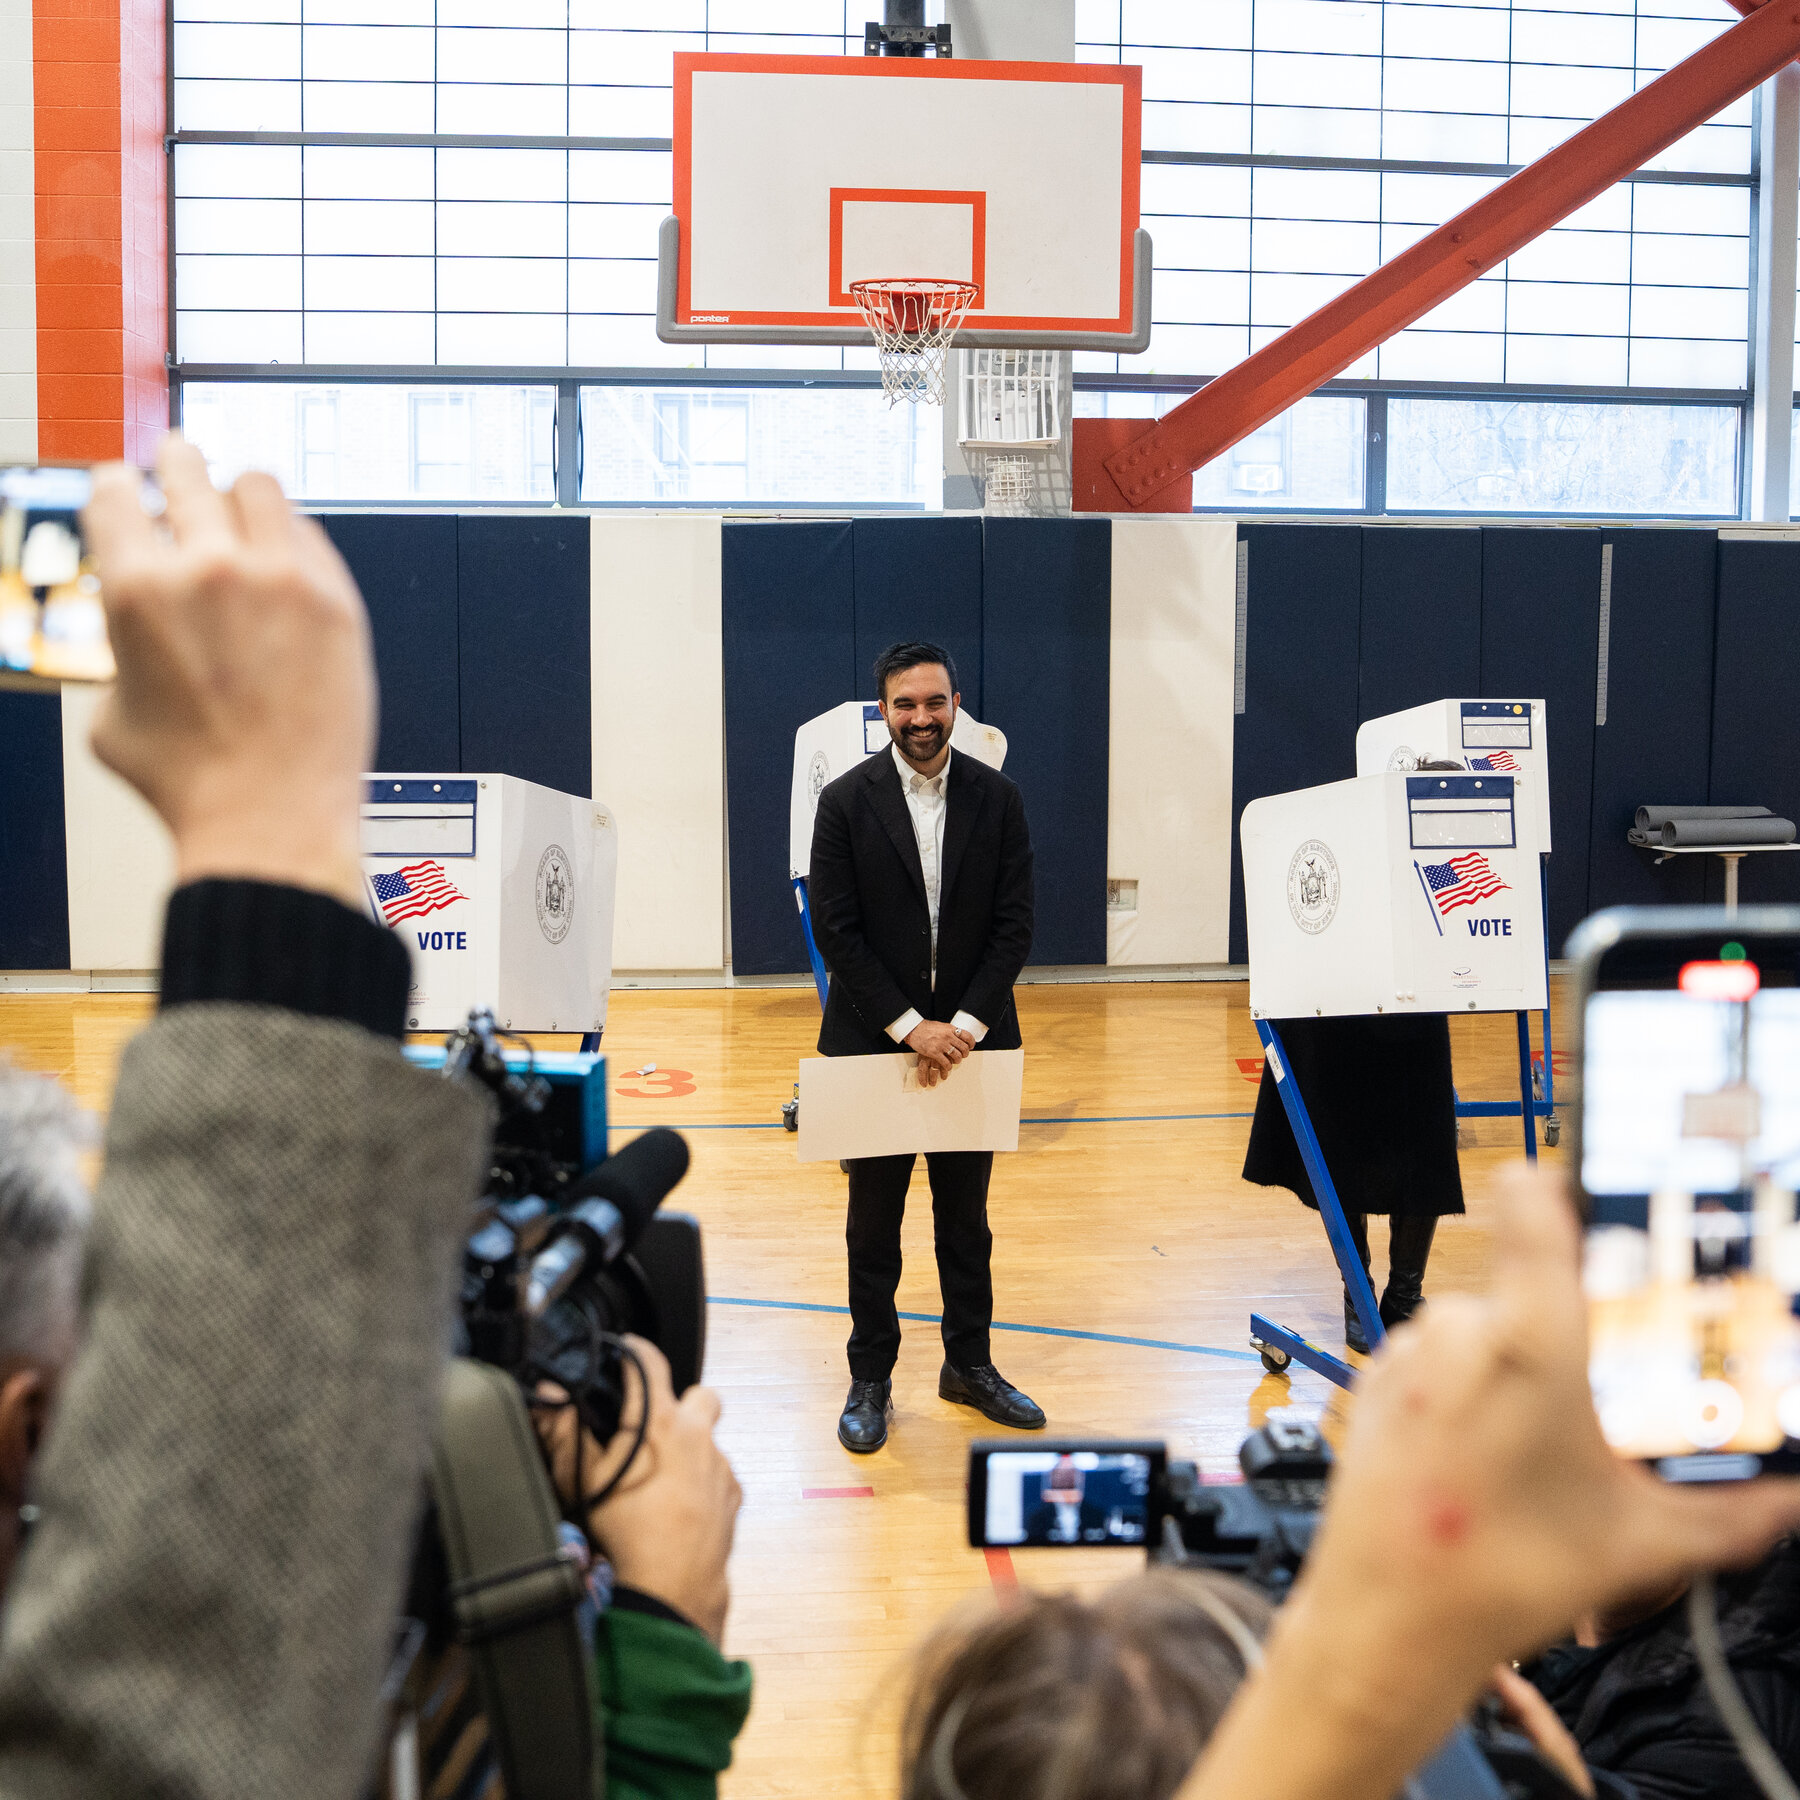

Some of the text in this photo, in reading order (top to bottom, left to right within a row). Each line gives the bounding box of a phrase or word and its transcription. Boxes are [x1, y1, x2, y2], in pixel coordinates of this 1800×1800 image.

[1467, 918, 1512, 936] VOTE
[417, 931, 467, 950] VOTE
[615, 1068, 697, 1098] 3
